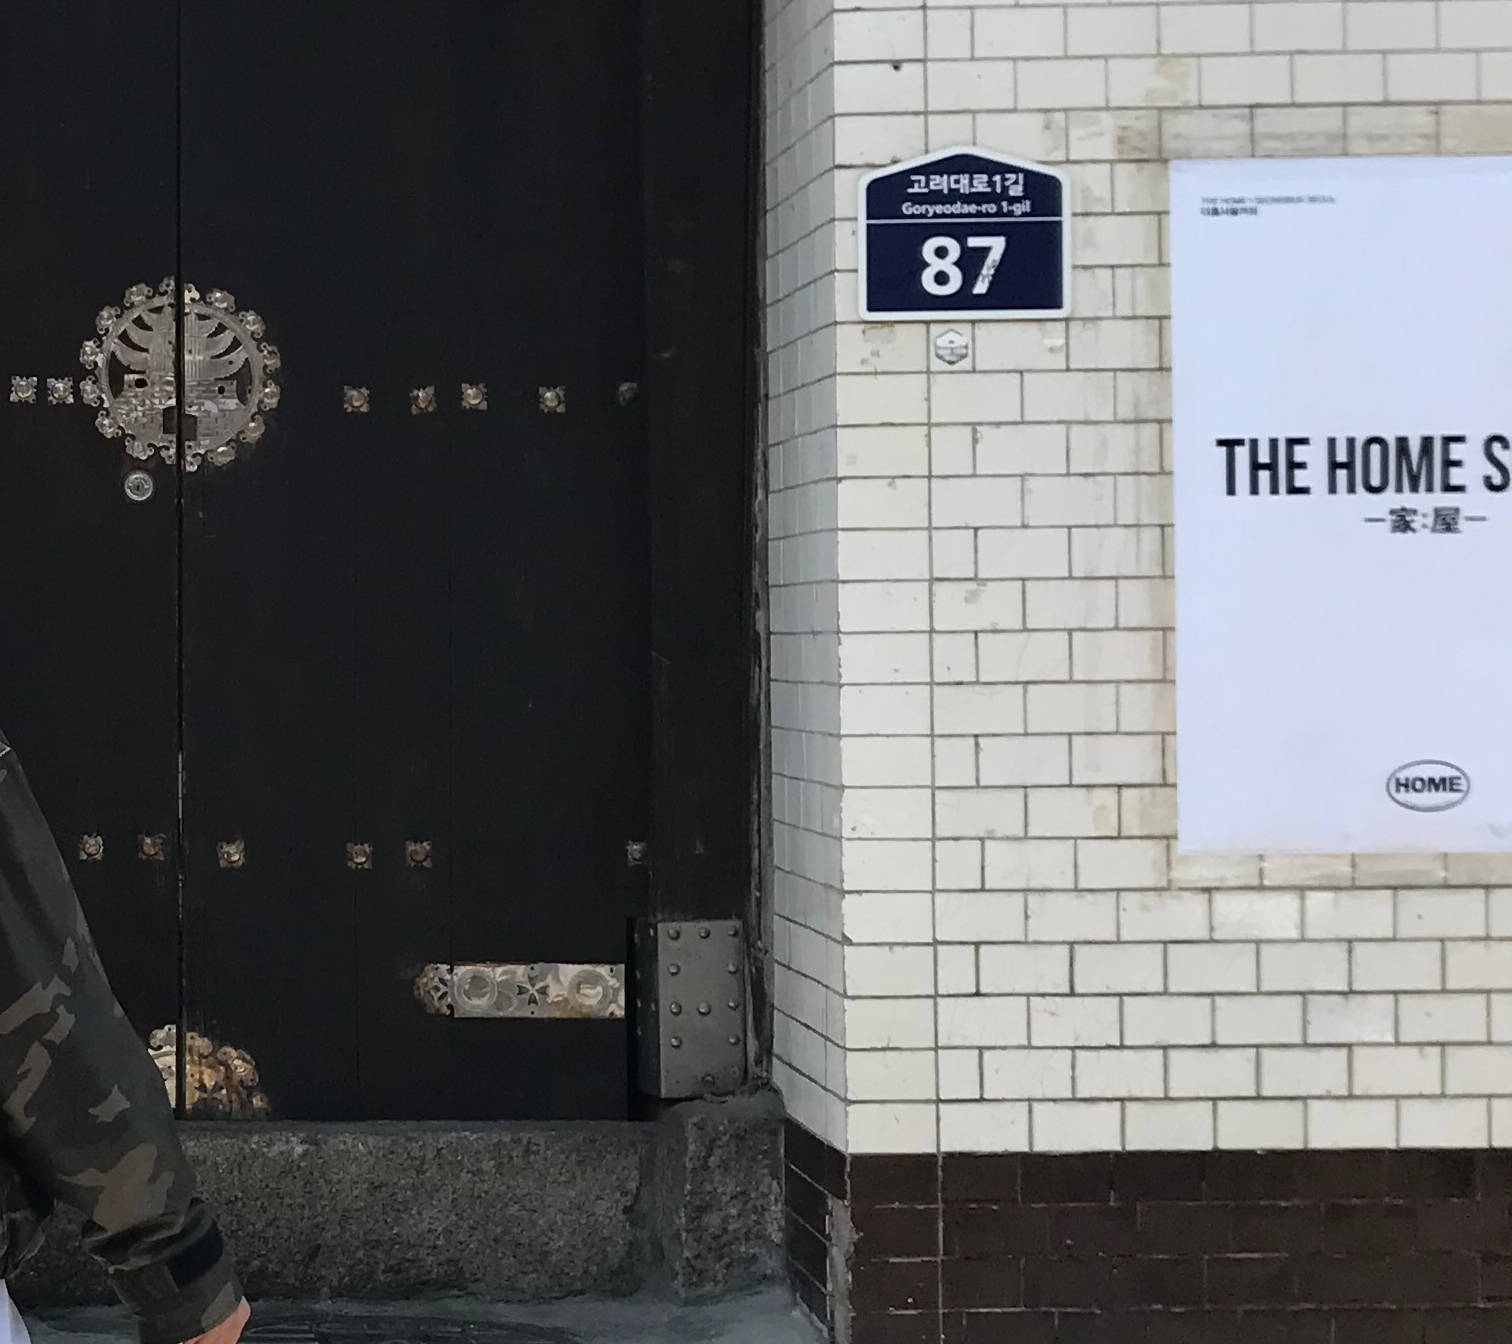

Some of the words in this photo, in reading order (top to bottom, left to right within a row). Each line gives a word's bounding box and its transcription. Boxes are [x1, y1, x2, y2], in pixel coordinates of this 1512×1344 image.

[906, 172, 1025, 197] 고려대로1길
[901, 201, 998, 218] Goryeodae-ro
[1001, 199, 1032, 217] 1-gil
[920, 235, 1007, 297] 87
[1215, 437, 1312, 496] THE
[1326, 435, 1467, 495] HOME
[1394, 775, 1465, 794] HOME
